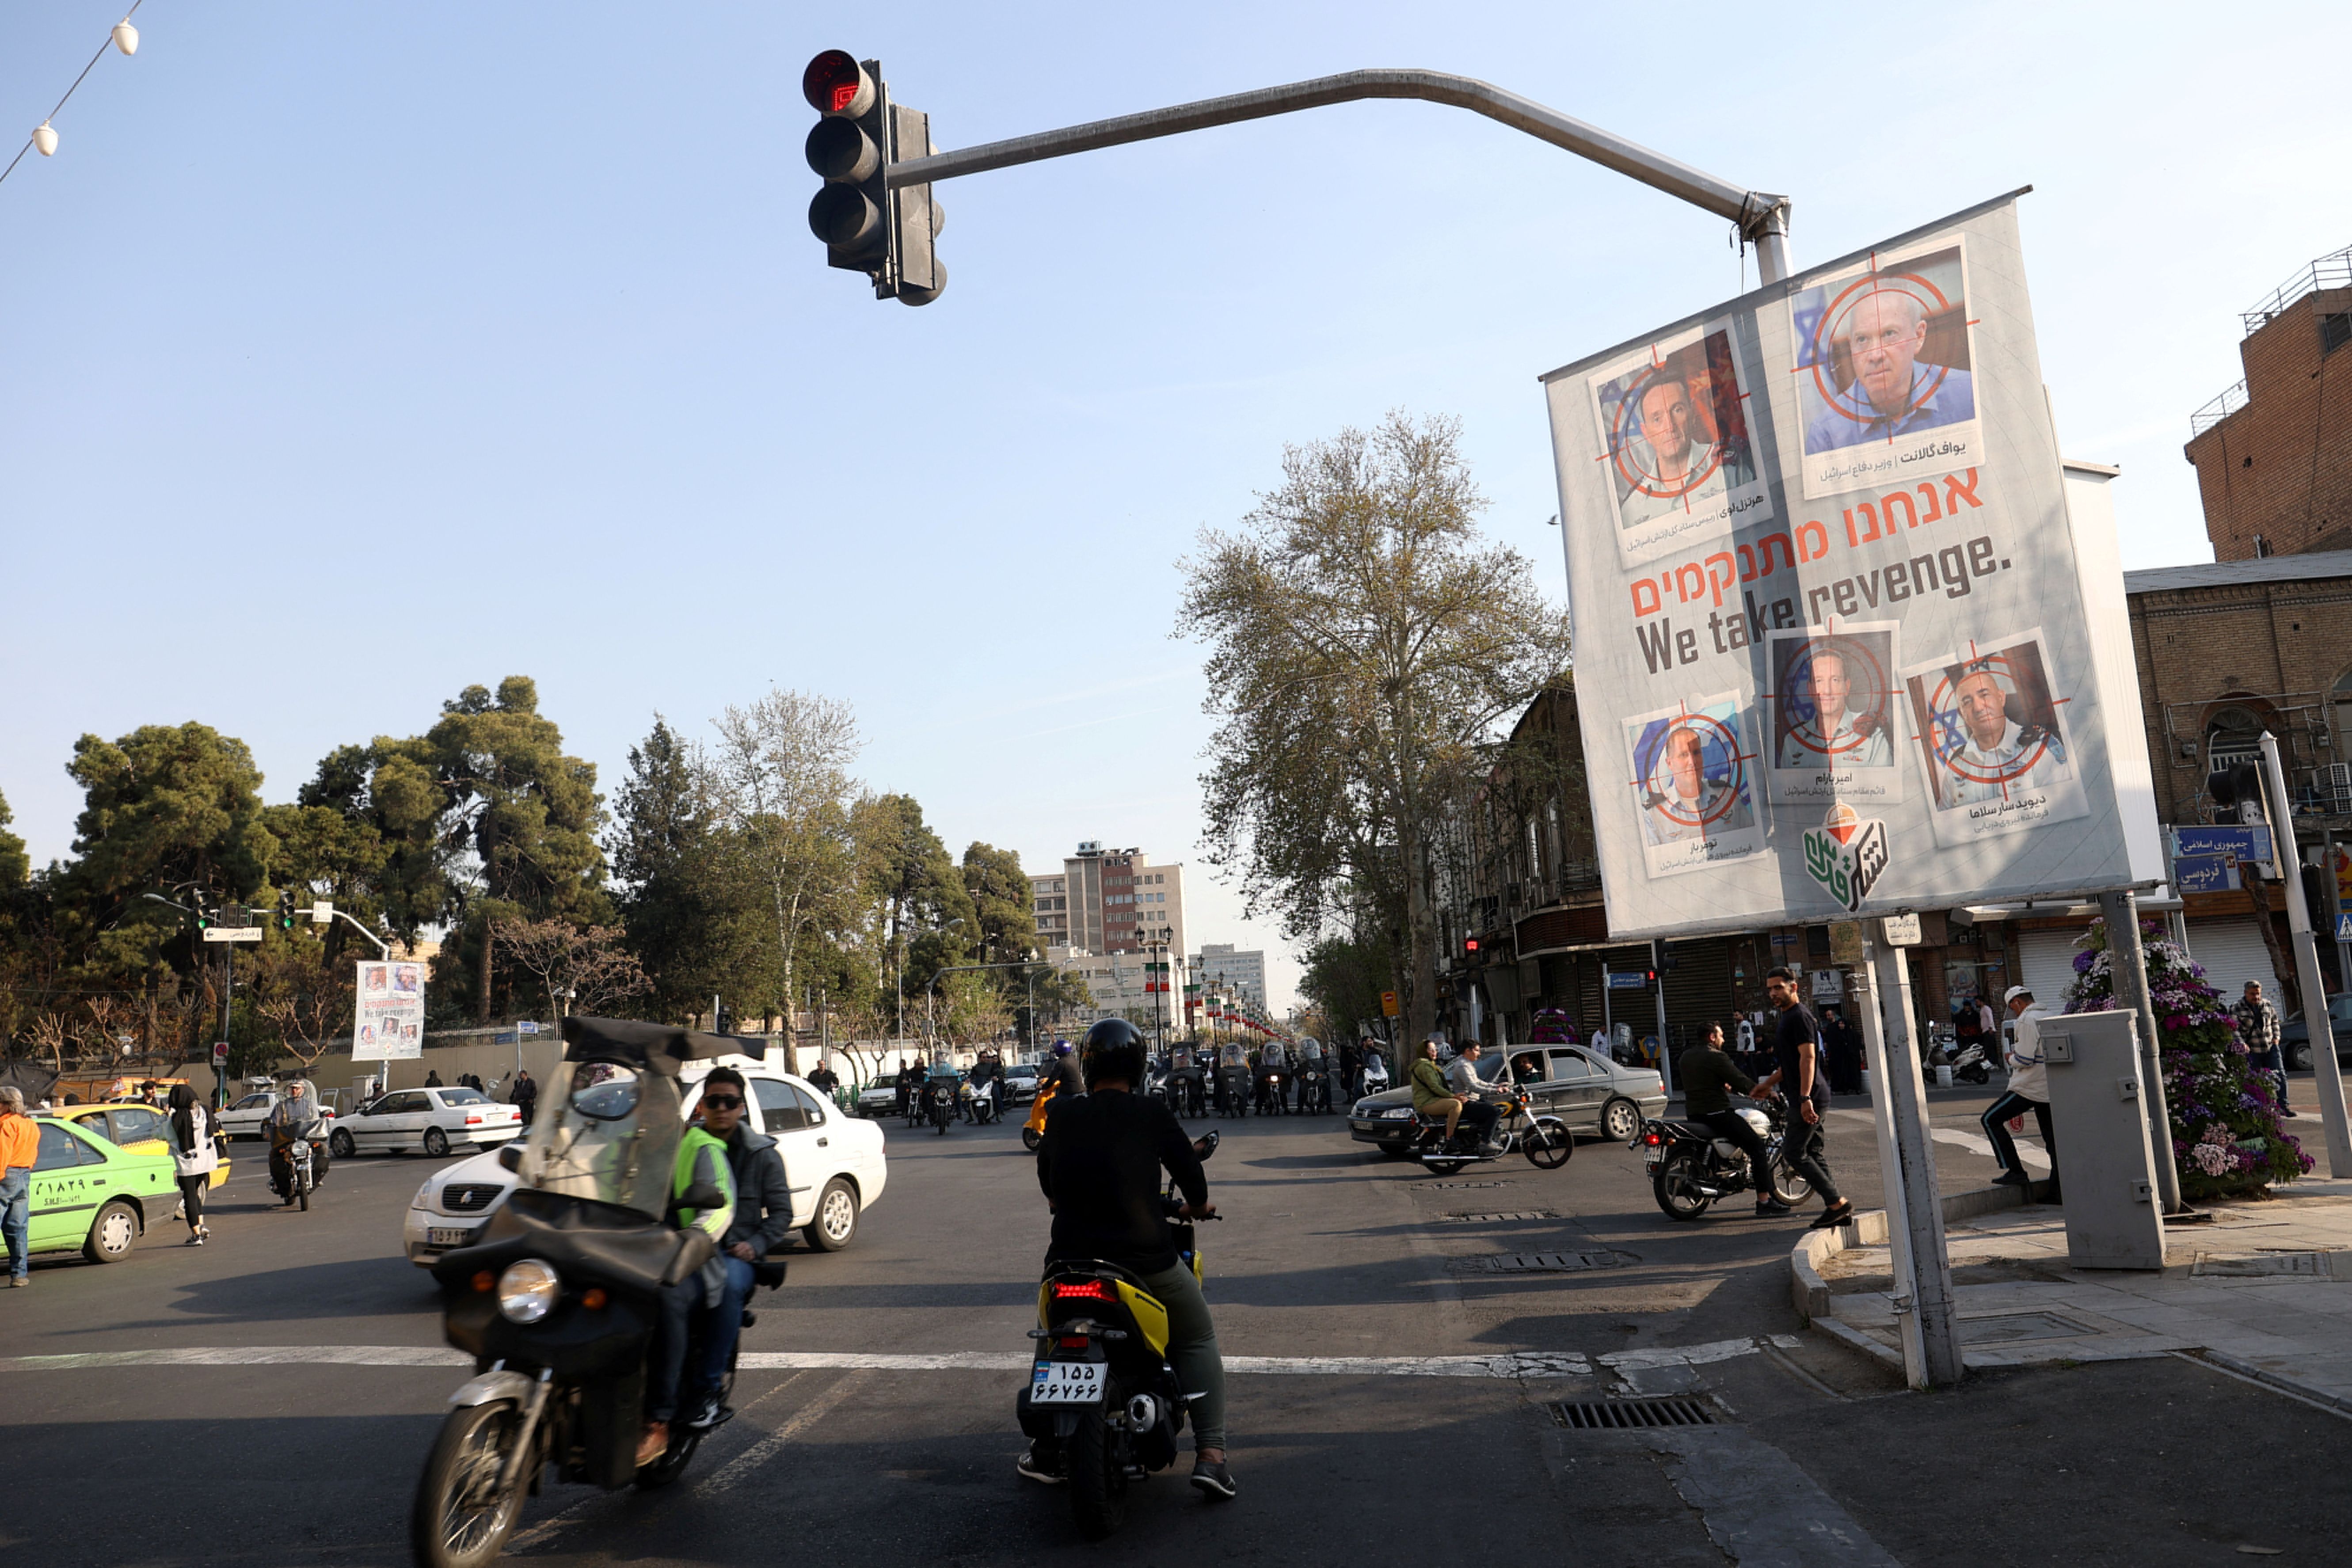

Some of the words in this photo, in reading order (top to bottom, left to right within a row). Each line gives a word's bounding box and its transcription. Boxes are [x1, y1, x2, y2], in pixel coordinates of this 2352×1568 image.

[1843, 466, 1983, 549] אנחנו
[1629, 519, 1830, 619] מתנקמים
[1636, 617, 1699, 675] We
[1708, 590, 1796, 655] take
[1808, 535, 2012, 626] revenge.
[2183, 839, 2213, 853] اسلامی
[2181, 862, 2220, 884] فردوسی
[1061, 1365, 1095, 1381] ۱۵۵
[1035, 1384, 1099, 1399] ۶۶۷۶۶
